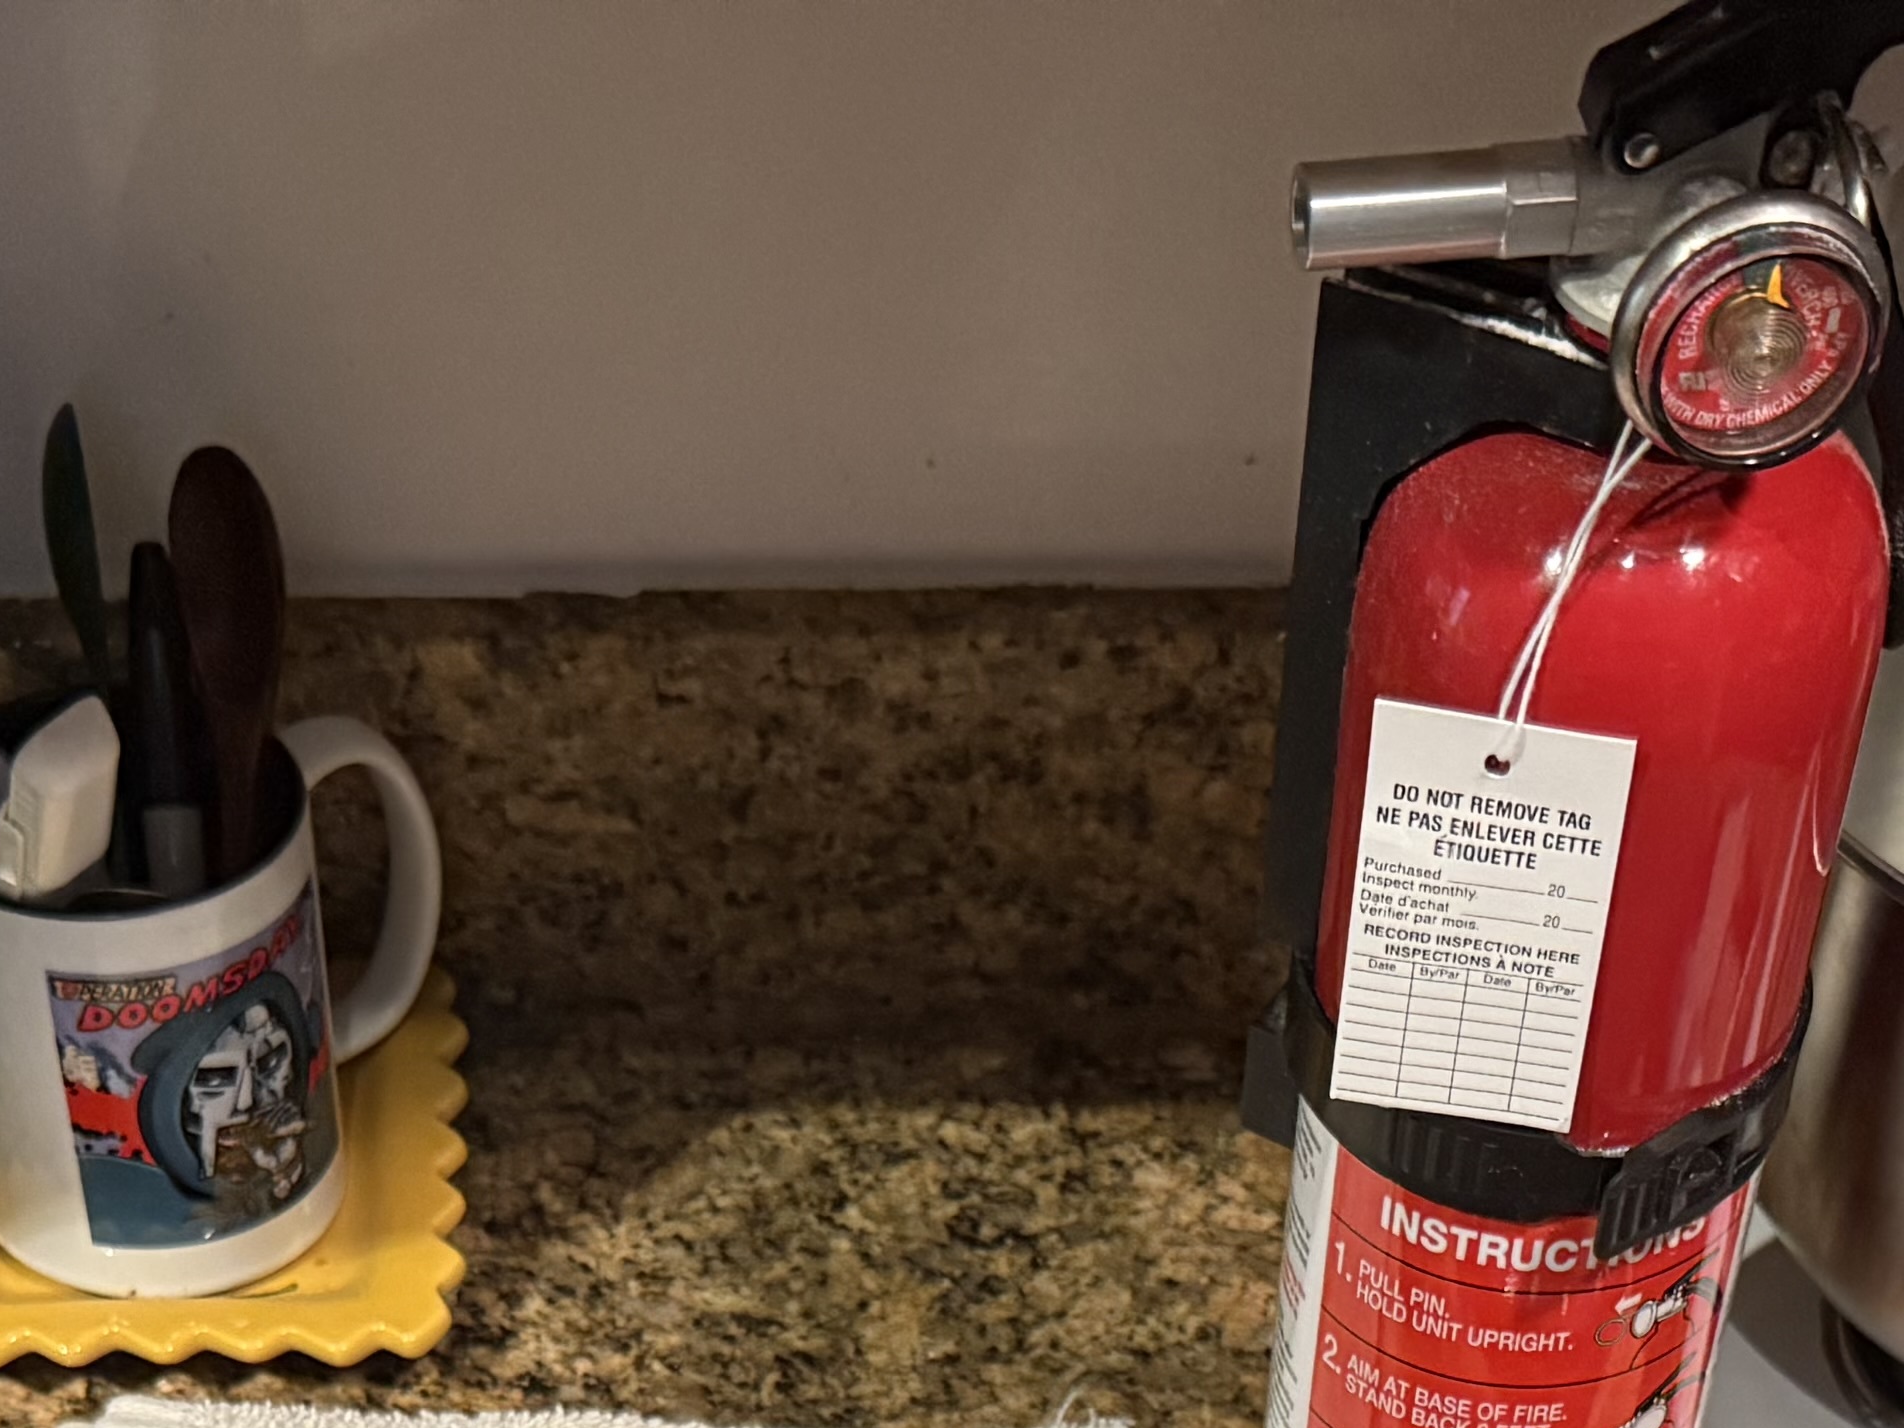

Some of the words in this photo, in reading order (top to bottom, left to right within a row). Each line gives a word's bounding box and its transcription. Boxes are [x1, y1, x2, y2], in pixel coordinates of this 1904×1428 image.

[1696, 409, 1725, 428] DRY
[1726, 392, 1802, 426] CHEMICAL
[1801, 359, 1833, 397] ONLY
[1393, 783, 1419, 803] DO
[1426, 789, 1464, 810] NOT
[1470, 796, 1550, 824] REMOVE
[1557, 810, 1592, 831] TAG
[1377, 806, 1401, 825] NE
[1408, 811, 1443, 832] PAS
[1449, 818, 1535, 847] ENLEVER
[1542, 833, 1602, 857] CETTE
[1434, 835, 1537, 870] ÉTIQUETTE
[1362, 872, 1414, 891] Inspect
[1418, 884, 1478, 901] monthly.
[1364, 857, 1441, 880] Purchased
[1547, 884, 1565, 898] 20
[1364, 924, 1431, 944] RECORD
[1436, 931, 1532, 958] INSPECTION
[1536, 949, 1581, 965] HERE
[1385, 944, 1491, 968] INSPECTIONS
[1511, 961, 1555, 978] NOTE
[76, 915, 301, 1032] DOOMSDAY
[1334, 1240, 1352, 1282] 1.
[1358, 1258, 1405, 1301] PULL
[1409, 1287, 1451, 1318] PIN.
[1355, 1286, 1406, 1324] HOLD
[1412, 1314, 1463, 1341] UNIT
[1467, 1328, 1574, 1353] UPRIGHT.
[1322, 1334, 1341, 1375] 2.
[1347, 1353, 1380, 1388] AIM
[1384, 1375, 1411, 1400] AT
[1414, 1386, 1471, 1420] BASE
[1477, 1402, 1507, 1422] OF
[1513, 1403, 1568, 1423] FIRE.
[1345, 1373, 1407, 1420] STAND
